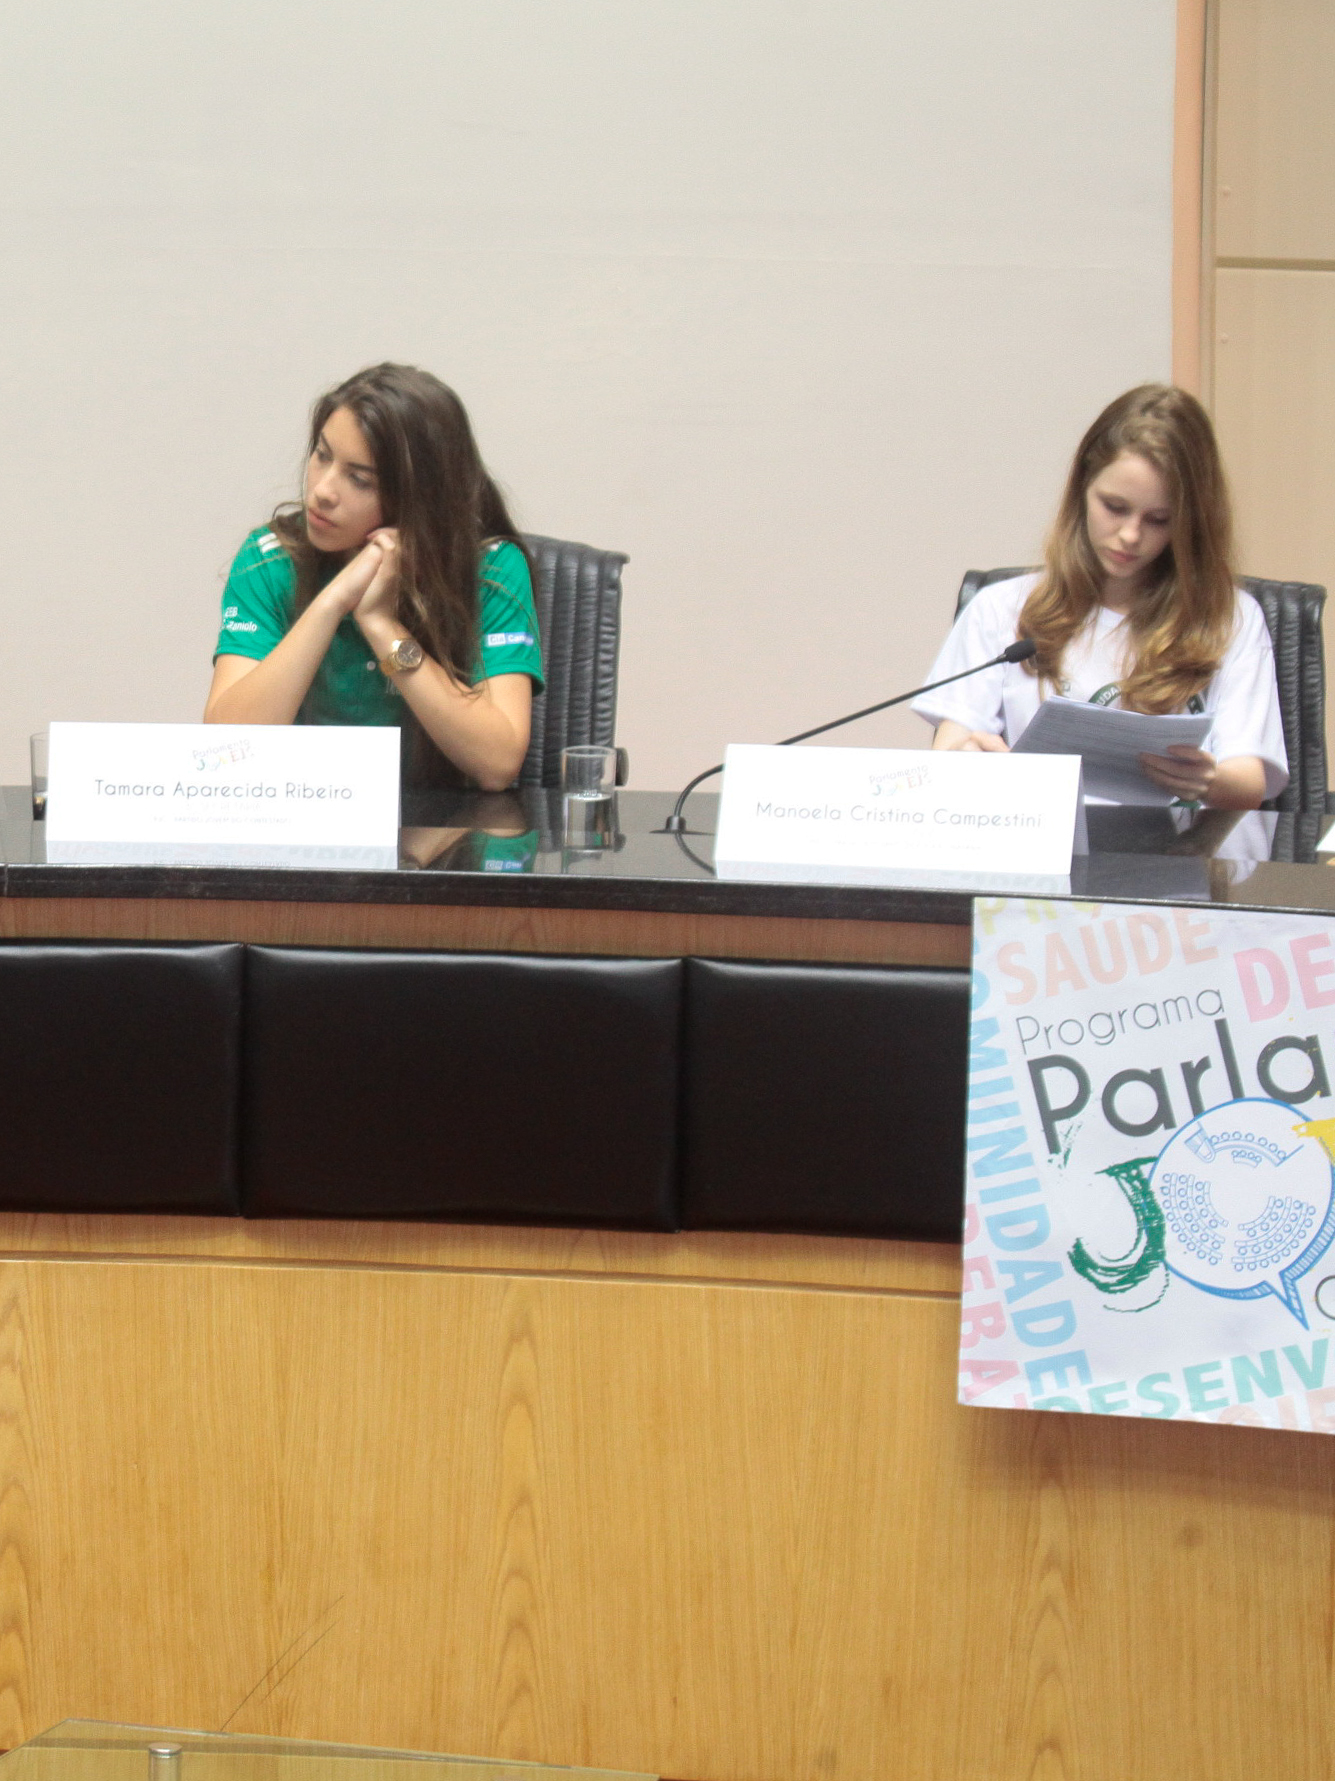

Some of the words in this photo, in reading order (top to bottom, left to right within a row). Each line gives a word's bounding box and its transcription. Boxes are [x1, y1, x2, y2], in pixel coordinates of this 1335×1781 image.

[94, 779, 165, 797] Tamara
[172, 781, 278, 800] Aparecida
[285, 782, 353, 801] Ribeiro
[756, 801, 842, 821] Manoela
[850, 804, 925, 824] Cristina
[933, 808, 1043, 829] Campestini
[996, 902, 1219, 1007] SAÚDE
[1016, 988, 1225, 1056] Programa
